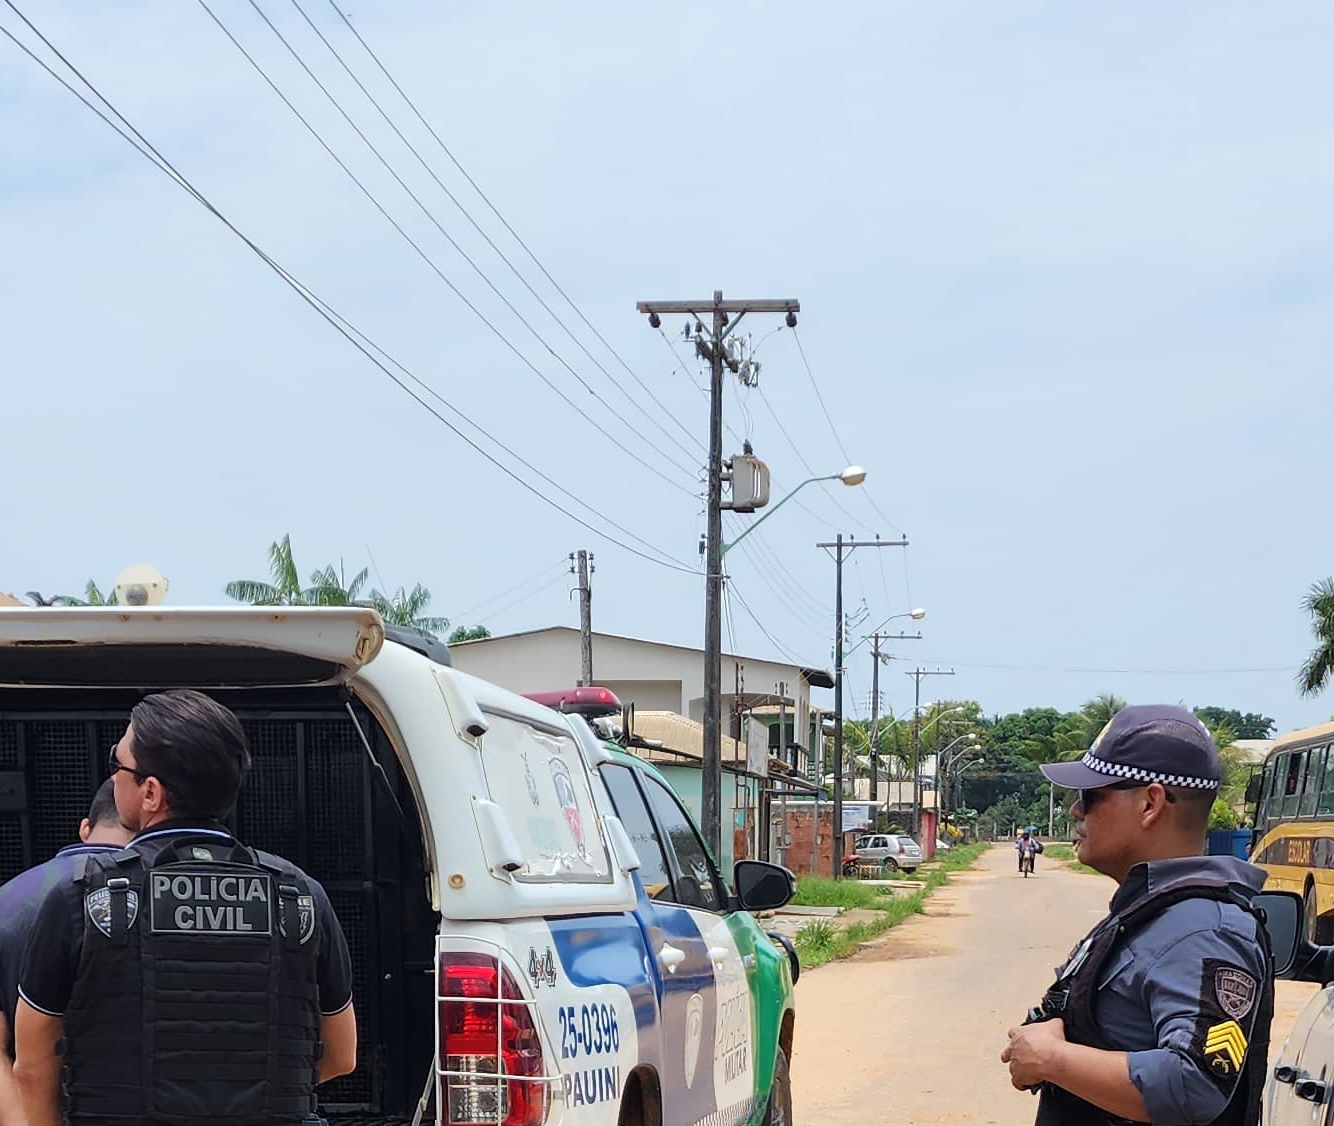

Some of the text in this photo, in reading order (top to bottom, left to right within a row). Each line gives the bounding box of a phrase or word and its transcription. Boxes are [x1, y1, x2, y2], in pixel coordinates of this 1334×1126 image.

[174, 905, 253, 931] CIVIL
[558, 1002, 620, 1059] 25-0396
[563, 1065, 620, 1110] PAUINI
